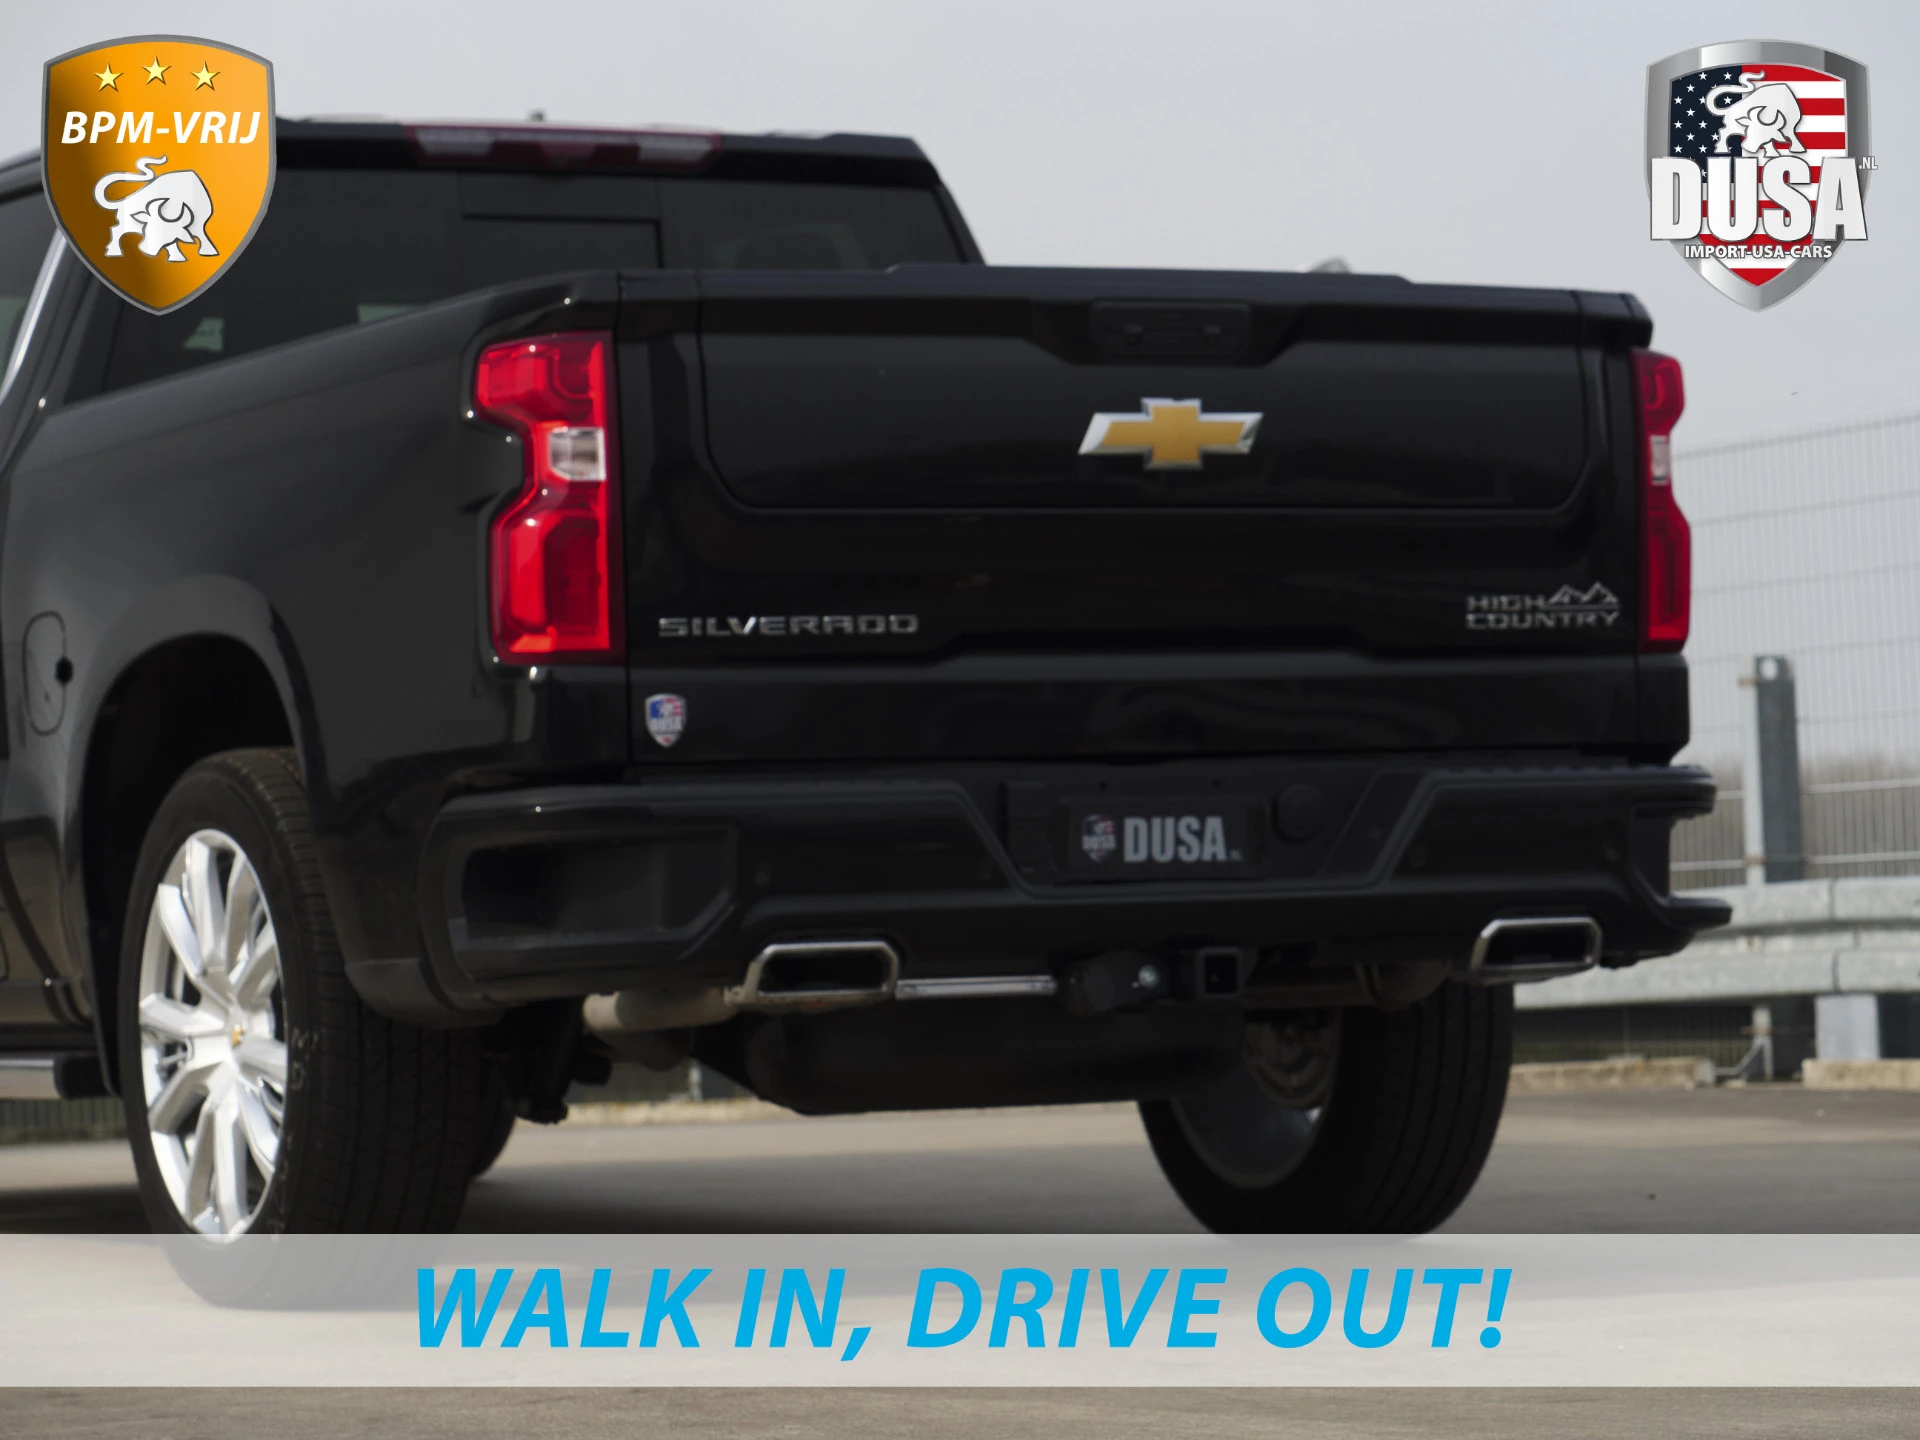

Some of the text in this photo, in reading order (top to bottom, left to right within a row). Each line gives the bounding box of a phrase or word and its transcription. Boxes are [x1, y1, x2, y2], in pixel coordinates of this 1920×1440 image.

[1467, 595, 1549, 612] HIGH
[658, 614, 919, 637] SILVERADO
[1466, 611, 1620, 630] COUNTRY
[1122, 815, 1226, 863] DUSA
